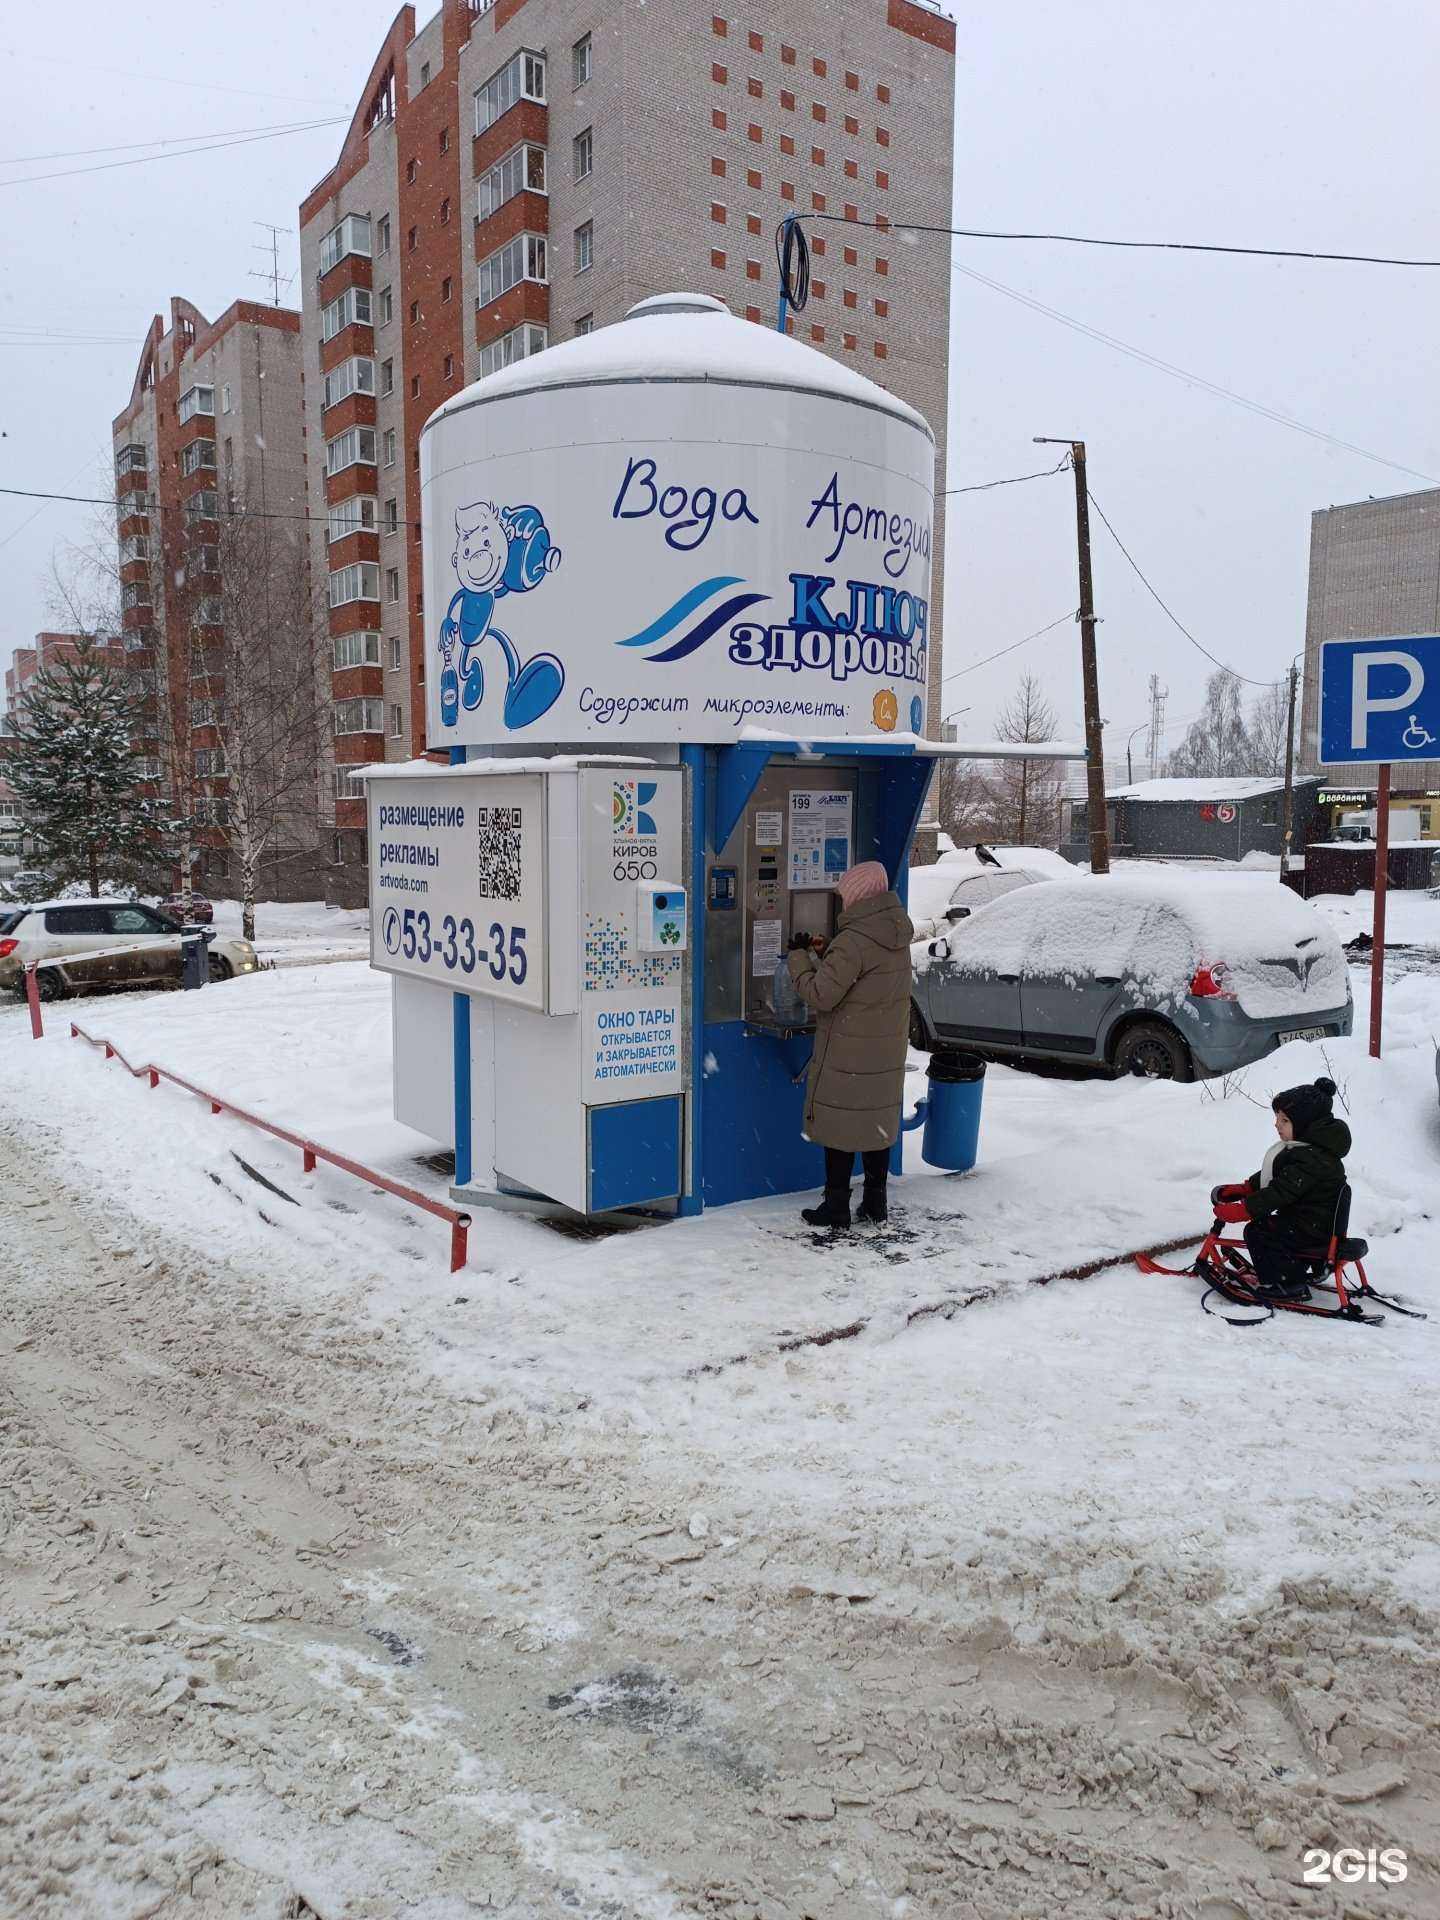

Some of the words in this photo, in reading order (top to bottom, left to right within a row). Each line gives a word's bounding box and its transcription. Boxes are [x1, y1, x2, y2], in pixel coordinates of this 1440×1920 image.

[613, 457, 759, 550] Вода
[579, 687, 688, 724] Содержит
[703, 697, 850, 726] микроэлементы:
[1351, 651, 1424, 749] P
[792, 798, 810, 809] 199
[379, 805, 464, 830] размещение
[379, 842, 439, 867] рекламы
[613, 846, 657, 857] КИРОВ
[613, 861, 657, 881] 650
[379, 873, 428, 893] artvoda.com
[402, 908, 528, 986] 53-33-35
[598, 1012, 635, 1029] ОКНО
[638, 1008, 675, 1026] ТАРЫ
[601, 1029, 671, 1046] ОТКРЫВАЕТСЯ
[596, 1051, 603, 1063] И
[605, 1044, 675, 1062] ЗАКРЫВАЕТСЯ
[594, 1060, 676, 1079] АВТОМАТИЧЕСКИ
